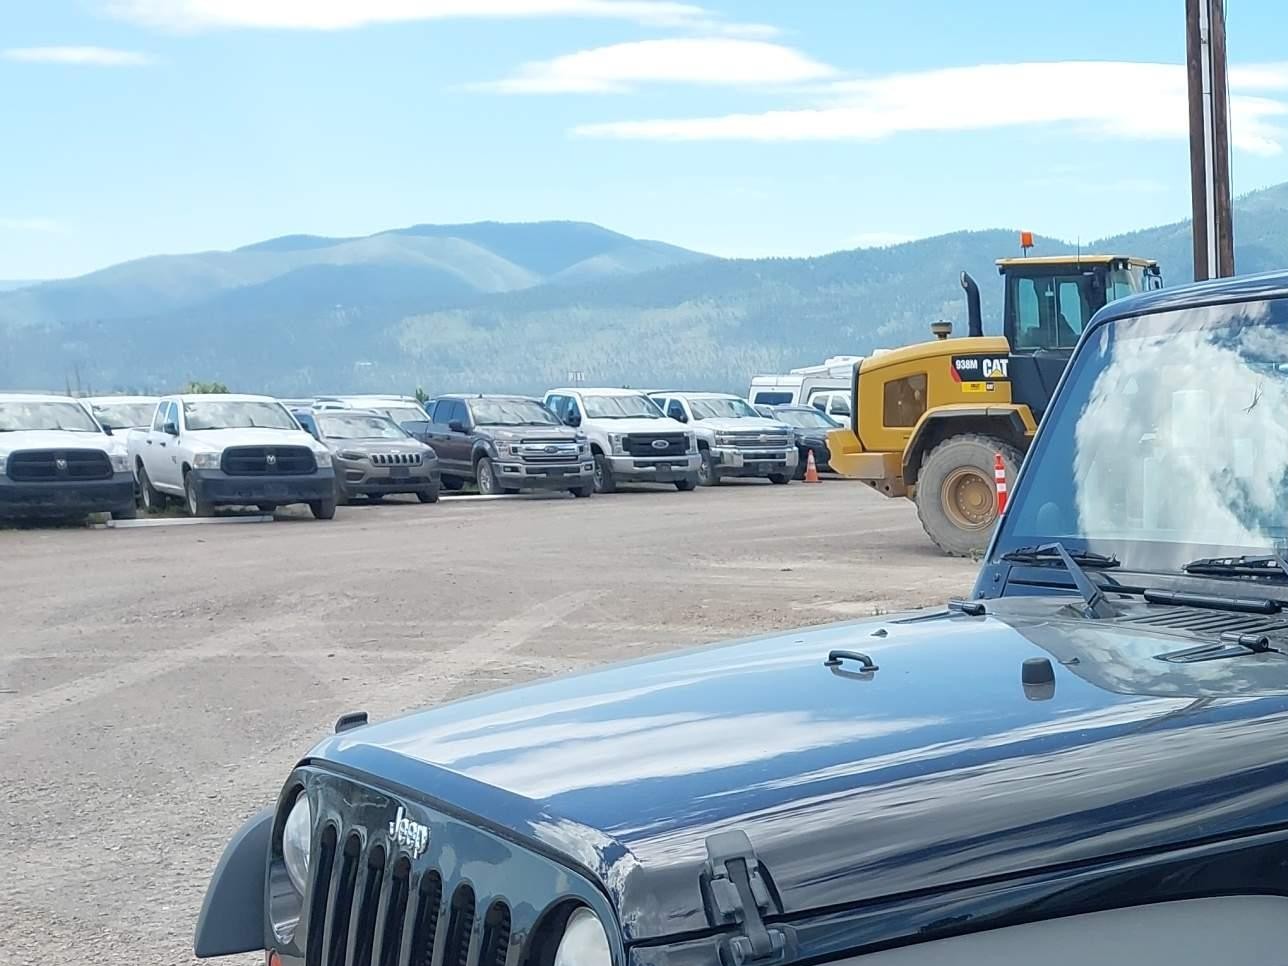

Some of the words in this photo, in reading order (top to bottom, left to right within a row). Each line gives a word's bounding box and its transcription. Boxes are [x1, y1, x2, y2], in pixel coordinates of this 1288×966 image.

[955, 359, 978, 370] 938M
[982, 359, 1009, 378] CAT
[389, 806, 428, 859] Jeep
